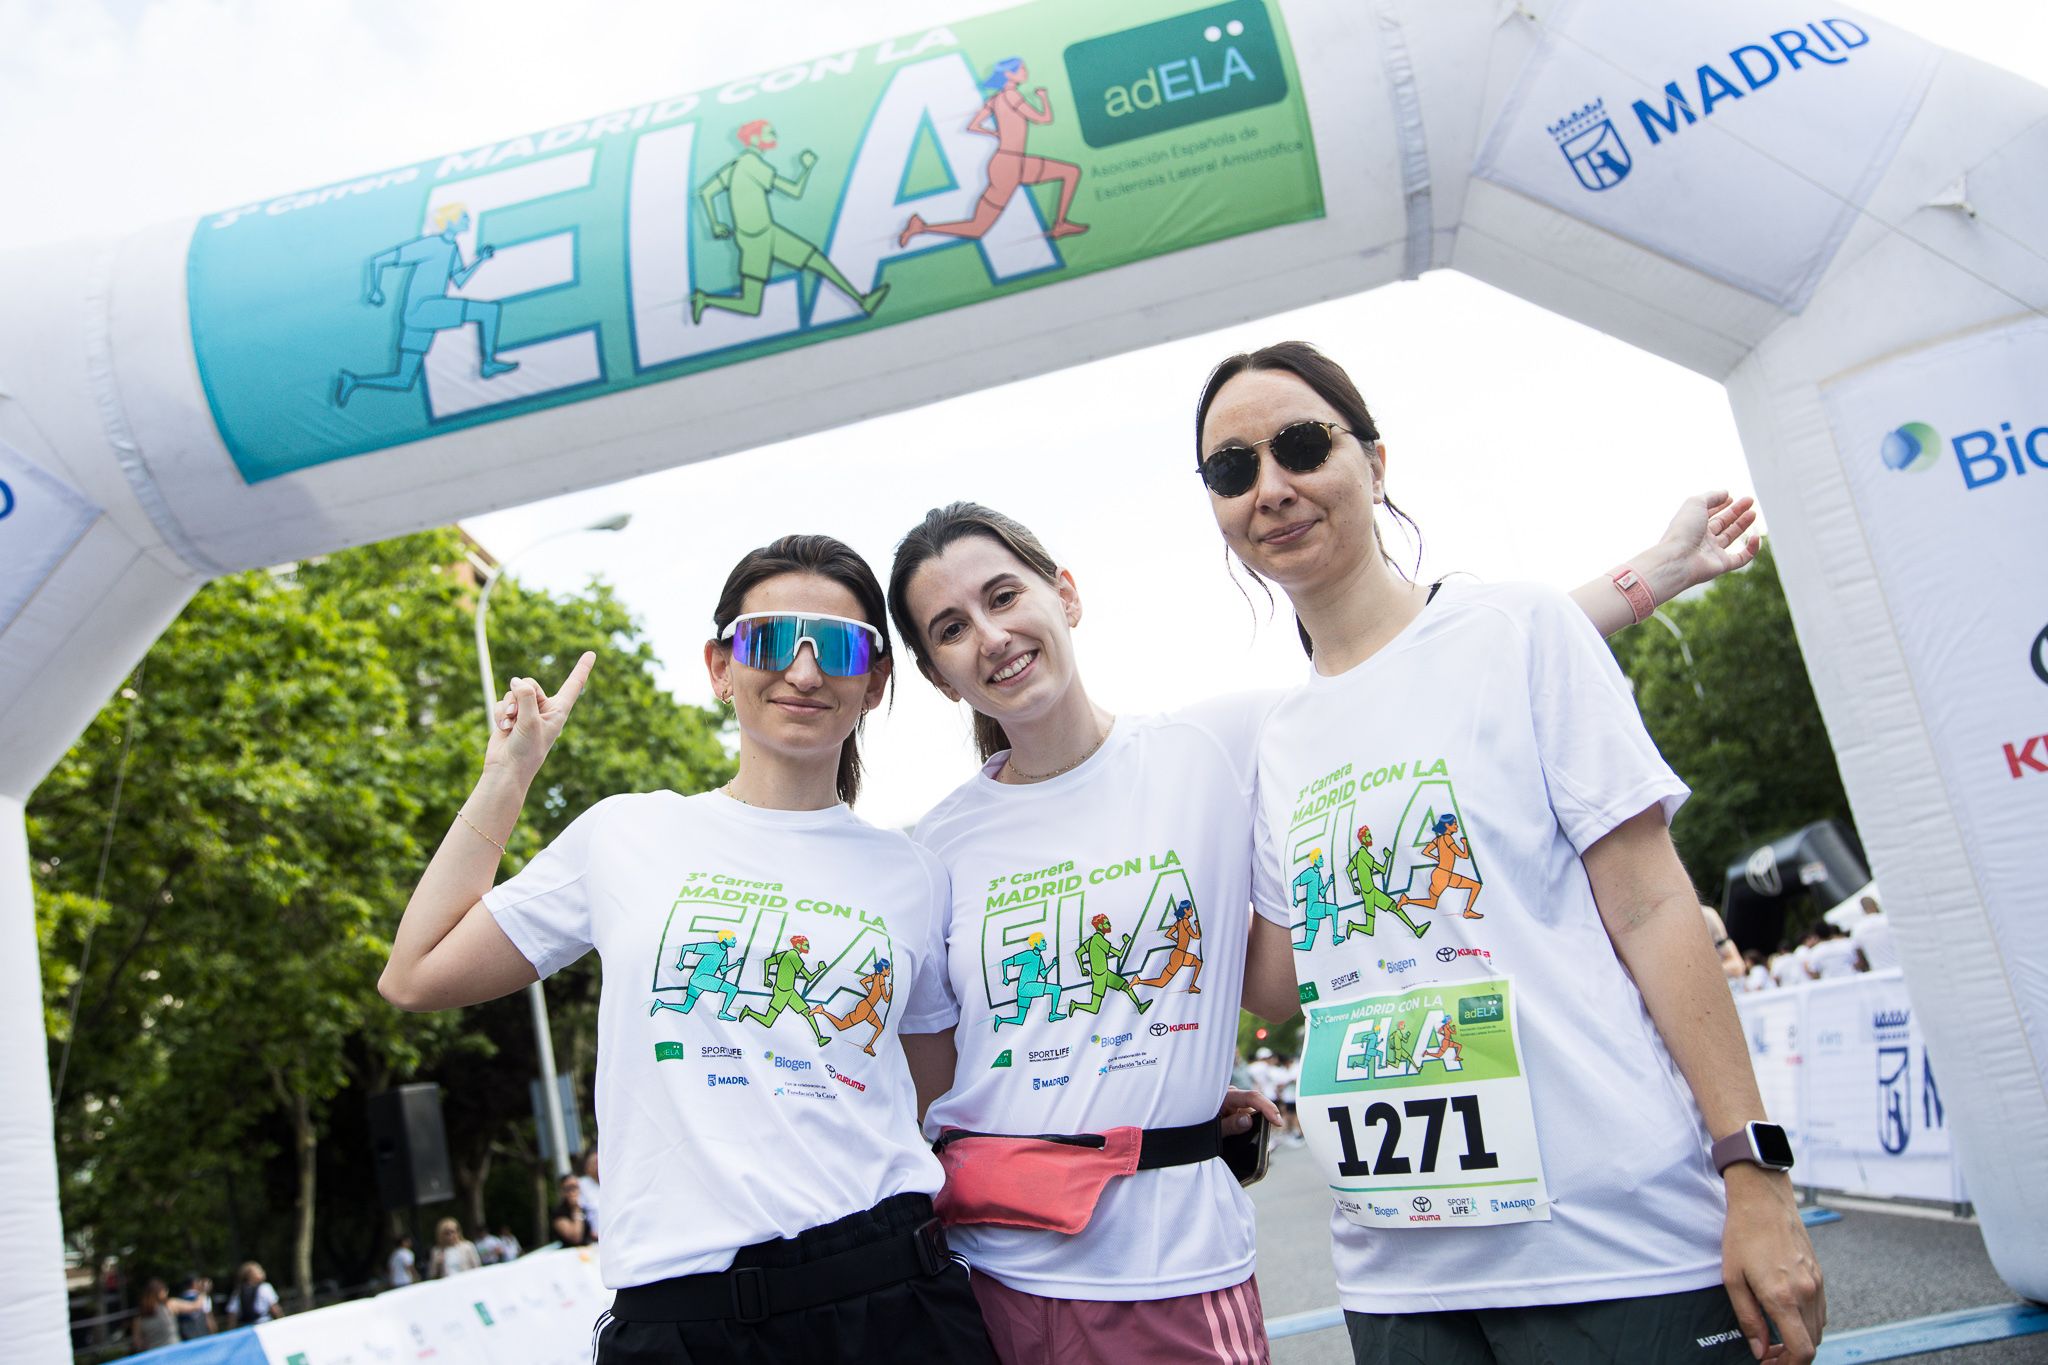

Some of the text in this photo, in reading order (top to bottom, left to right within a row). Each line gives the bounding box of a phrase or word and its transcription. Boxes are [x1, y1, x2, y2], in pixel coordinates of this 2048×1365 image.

[1103, 46, 1257, 118] adELA
[1631, 18, 1871, 146] MADRID
[264, 167, 421, 217] Carrera
[434, 95, 701, 179] MADRID
[716, 49, 860, 105] CON
[875, 27, 959, 66] LA
[1090, 126, 1259, 178] Asociación Española de
[1094, 139, 1304, 202] Esclerosis Lateral Amiotrófica
[423, 51, 1067, 425] ELA
[1310, 763, 1353, 795] Carrera
[2002, 735, 2048, 780] K
[1291, 758, 1449, 826] MADRID CON LA
[988, 860, 1075, 892] 3ª Carrera
[1284, 779, 1484, 930] ELA
[686, 872, 783, 892] 3ª Carrera
[985, 849, 1181, 912] MADRID CON LA
[678, 885, 888, 931] MADRID CON LA
[981, 868, 1204, 1010] ELA
[651, 899, 895, 1030] ELA
[1350, 1002, 1395, 1020] MADRID
[1398, 998, 1421, 1015] CON
[1423, 994, 1444, 1008] LA
[1464, 1006, 1497, 1019] adELA
[1101, 1032, 1133, 1048] Biogen
[1335, 1009, 1464, 1082] ELA
[774, 1056, 812, 1071] Biogen
[1041, 1075, 1070, 1088] MADRID
[1108, 1062, 1135, 1071] Fundación
[1327, 1094, 1499, 1177] 1271
[1373, 1206, 1399, 1217] Biogen
[1447, 1198, 1470, 1206] SPORT
[1451, 1206, 1469, 1215] LIFE
[1500, 1198, 1536, 1210] MADRID
